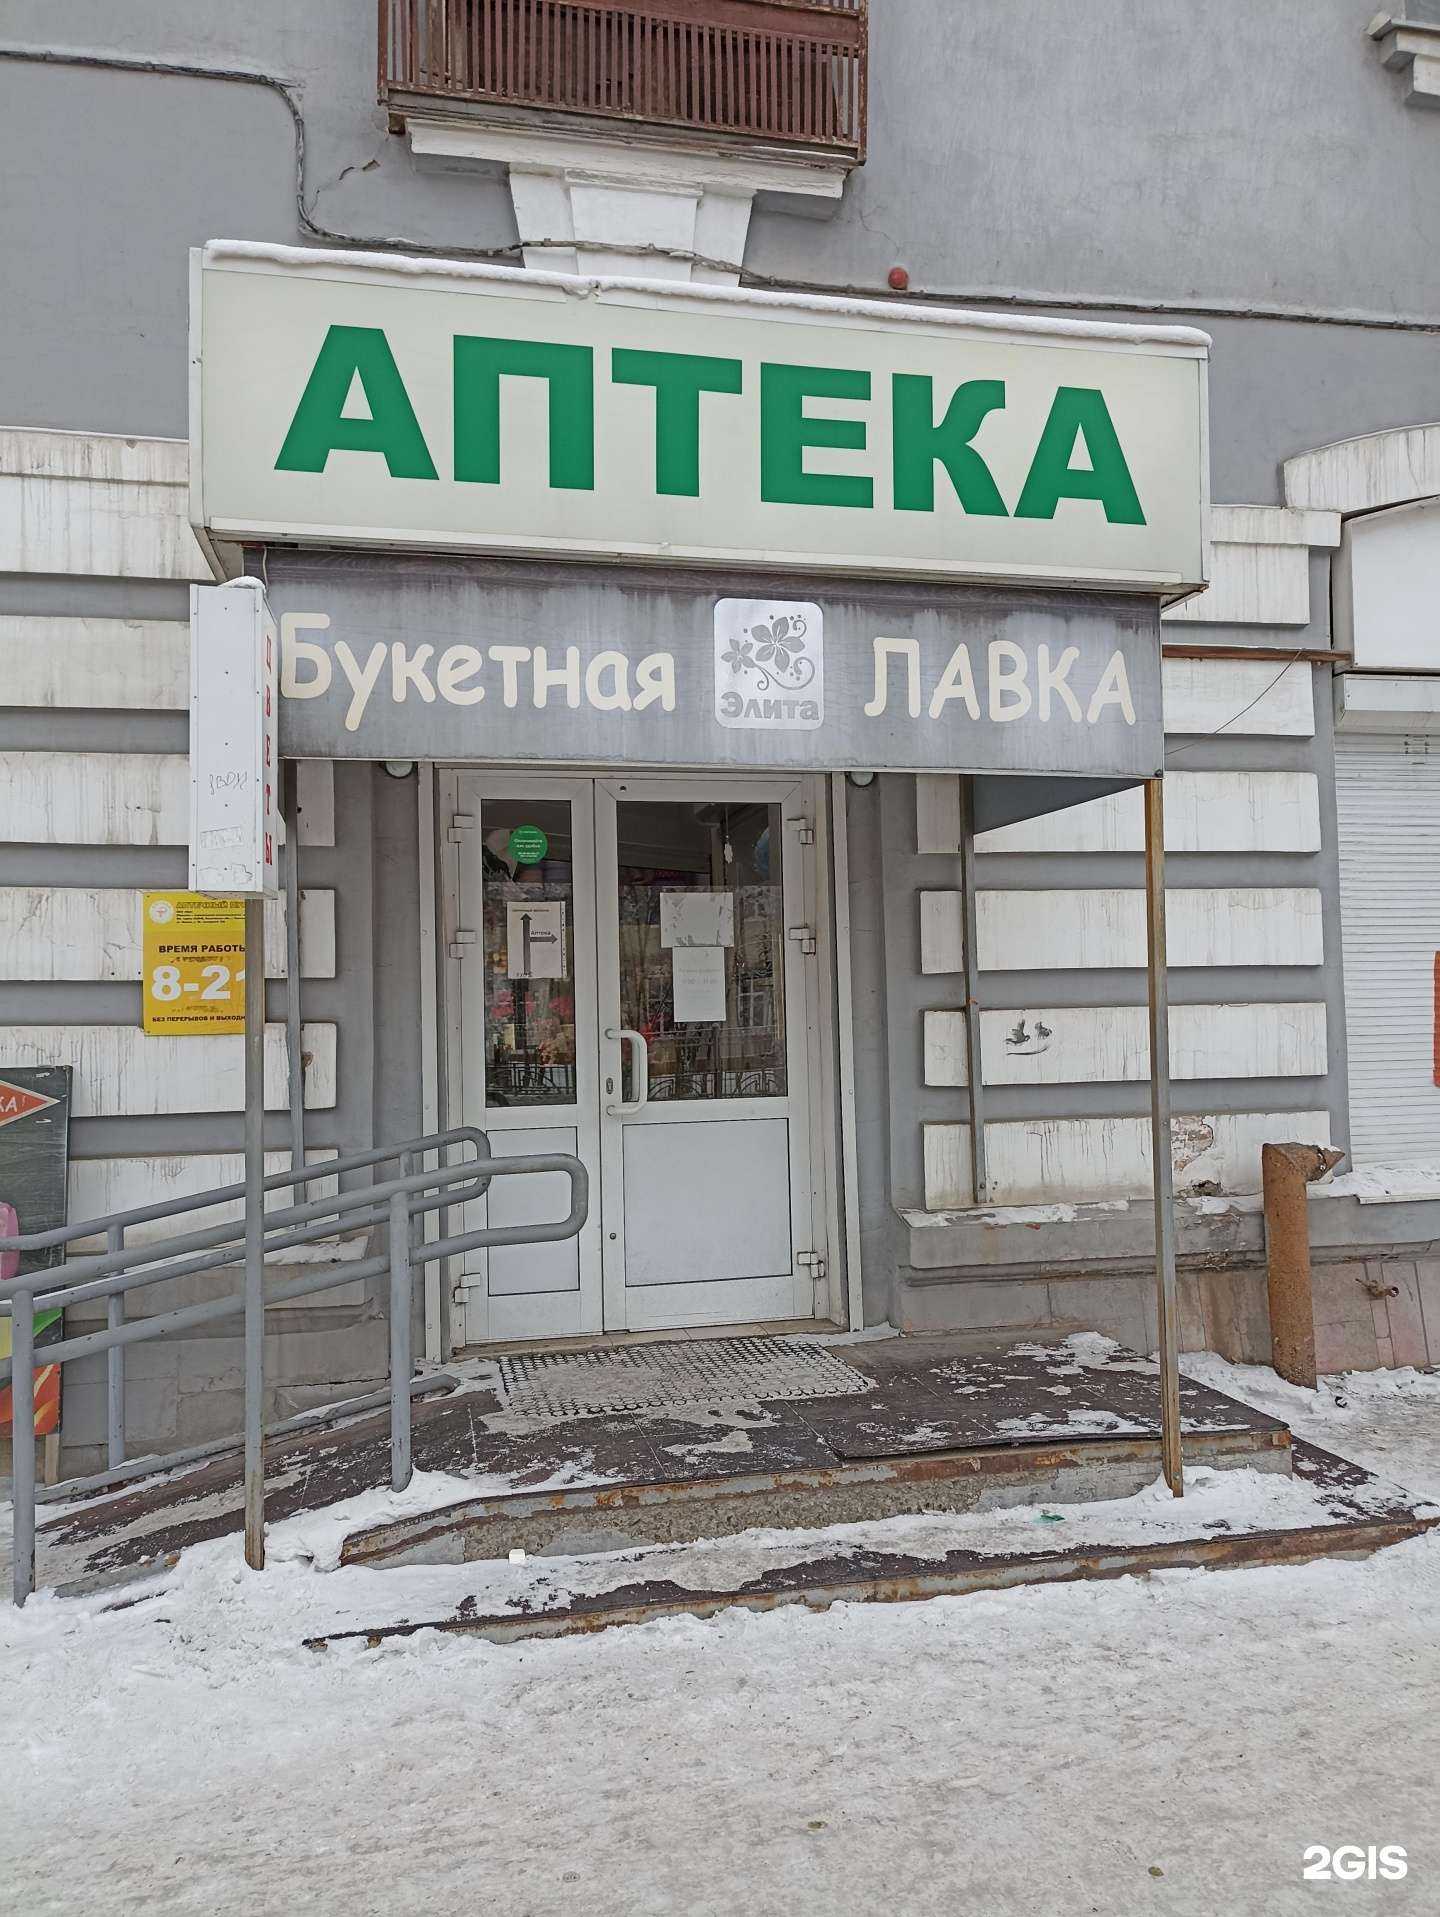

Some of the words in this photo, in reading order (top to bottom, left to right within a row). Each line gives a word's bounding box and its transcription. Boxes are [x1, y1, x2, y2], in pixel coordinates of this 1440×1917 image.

[274, 324, 1148, 526] АПТЕКА
[280, 611, 676, 732] Букетная
[864, 636, 1137, 726] ЛАВКА
[720, 691, 820, 721] Элита
[158, 945, 198, 953] ВРЕМЯ
[151, 965, 246, 1001] 8-2
